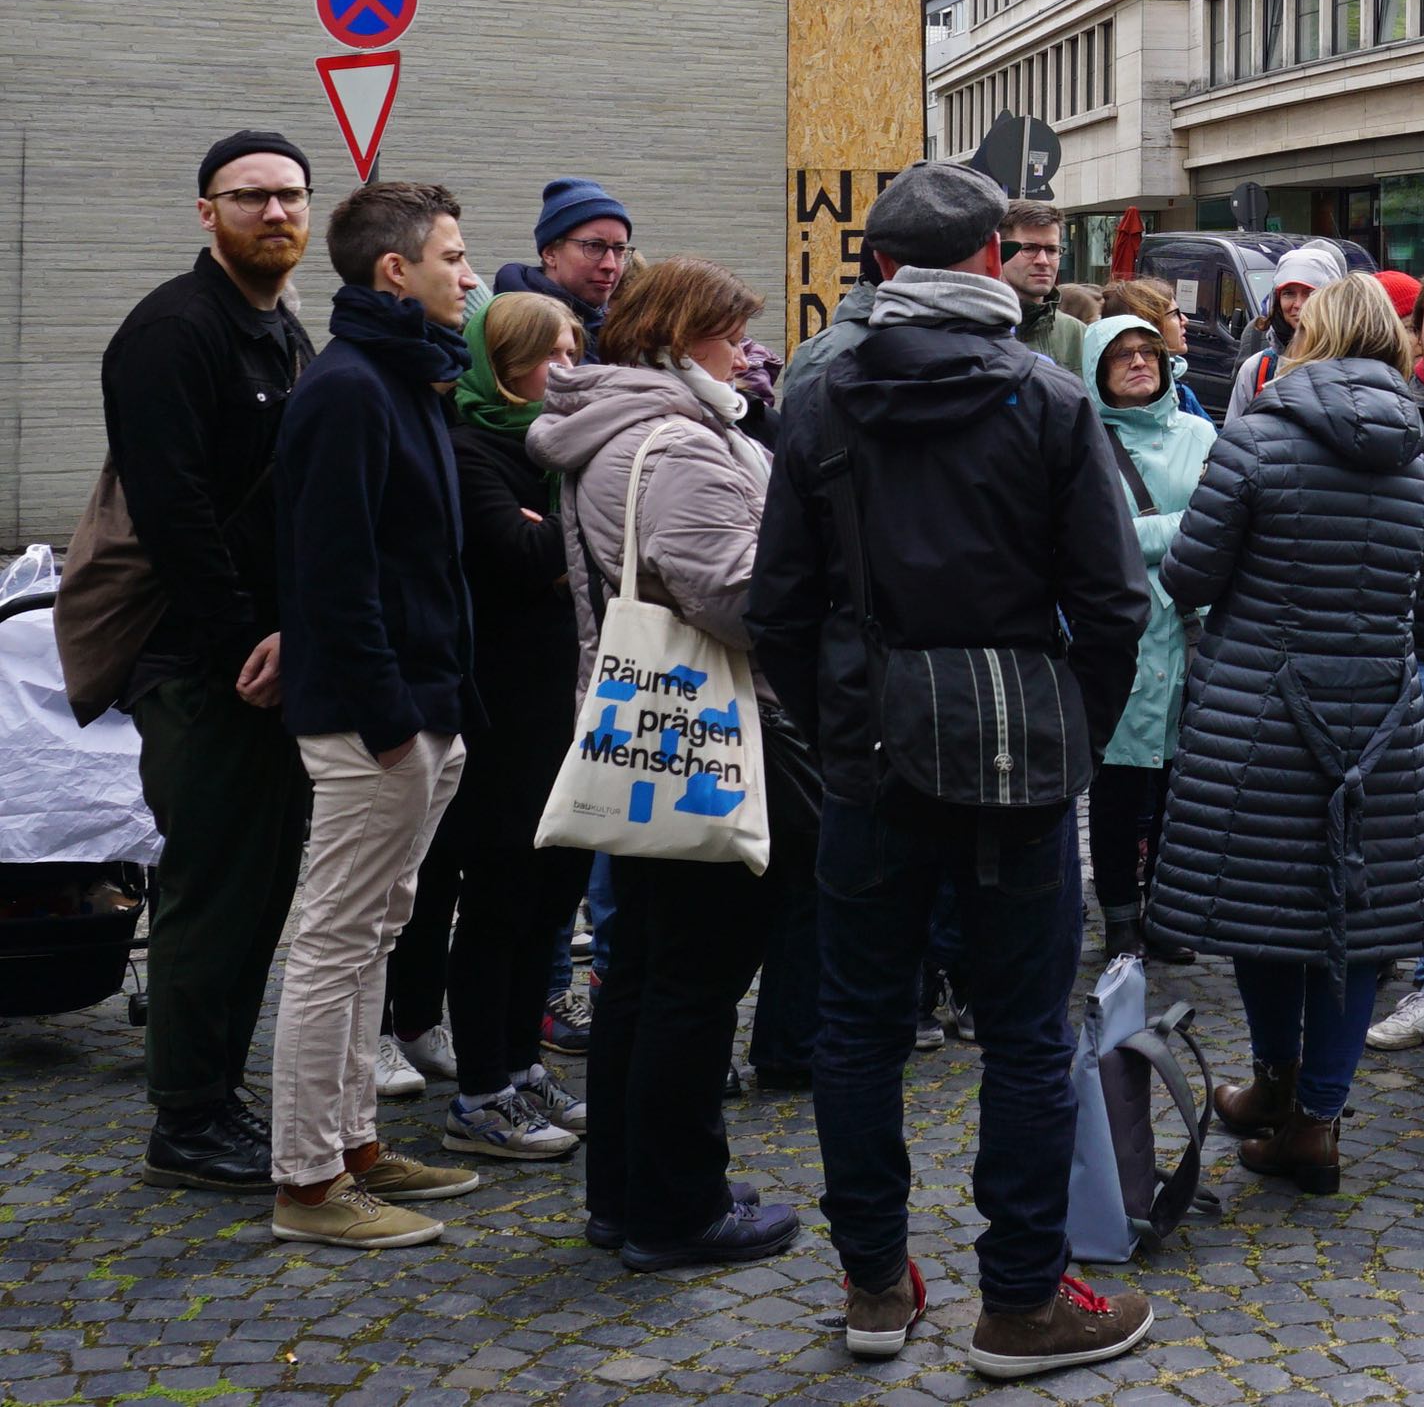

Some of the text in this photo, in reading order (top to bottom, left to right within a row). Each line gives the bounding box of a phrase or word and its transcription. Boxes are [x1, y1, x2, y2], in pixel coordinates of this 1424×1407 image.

[599, 655, 698, 701] Räume
[637, 707, 742, 748] prägen
[581, 731, 741, 783] Menschen
